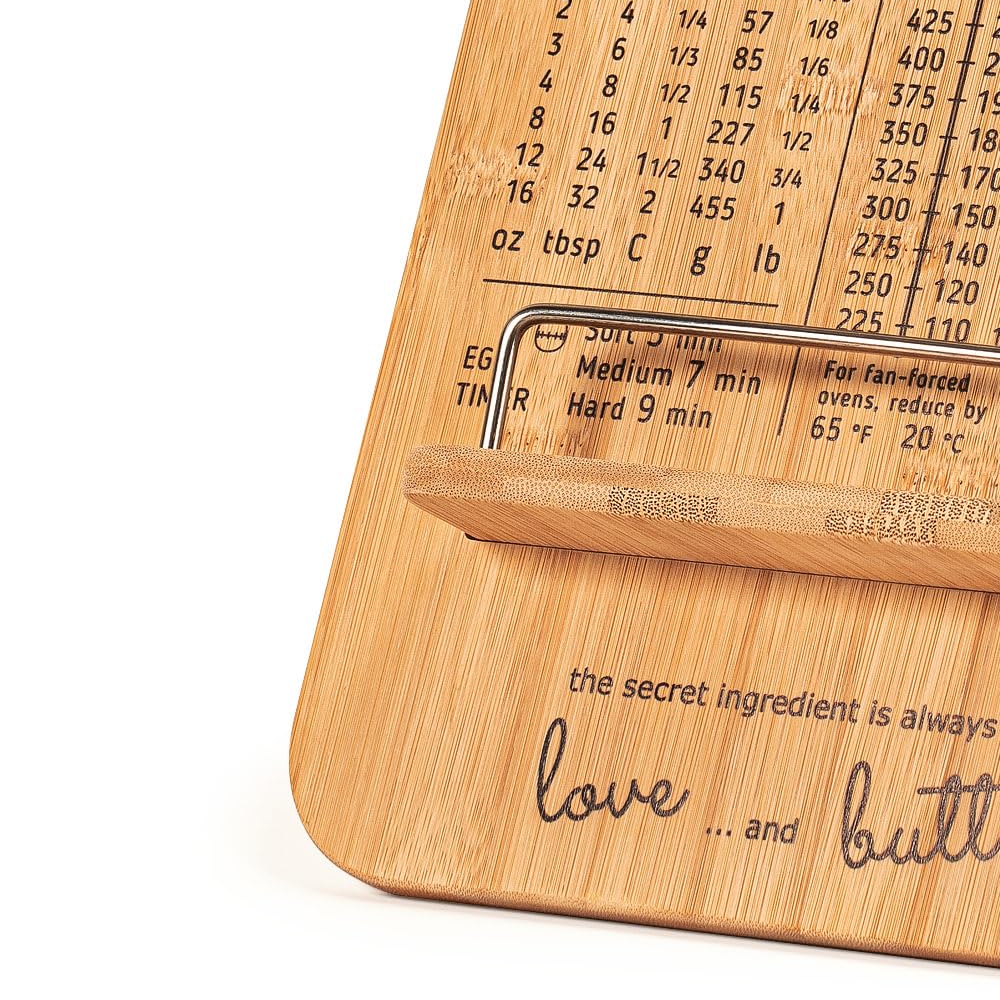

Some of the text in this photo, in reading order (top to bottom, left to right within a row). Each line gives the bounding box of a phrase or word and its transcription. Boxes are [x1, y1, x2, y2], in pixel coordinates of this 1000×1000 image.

[679, 9, 839, 40] 1/4 57 1/8
[906, 7, 954, 35] 425
[670, 46, 830, 77] 1/3 85 1/6
[897, 45, 946, 73] 400
[661, 83, 820, 114] 1/2 115 1/4
[888, 82, 937, 110] 375
[589, 110, 813, 152] 16 227 1/2
[879, 119, 928, 147] 350
[516, 142, 802, 189] 12 24 340 3/4
[870, 157, 919, 185] 325
[507, 179, 737, 221] 16 32 455
[862, 194, 997, 230] 300 150
[491, 228, 781, 277] oz tbsp C g lb
[852, 232, 989, 268] 275 140
[844, 270, 980, 306] 250 120
[463, 345, 494, 371] EG
[576, 354, 761, 395] Medium 7 min
[823, 359, 972, 394] For fan-forced
[567, 392, 712, 429] Hard 9 min
[818, 390, 988, 425] ovens, reduce by
[810, 415, 842, 442] 65
[900, 423, 934, 451] 20
[569, 667, 998, 739] the secret ingredient is always
[536, 717, 690, 823] love
[744, 813, 799, 844] and
